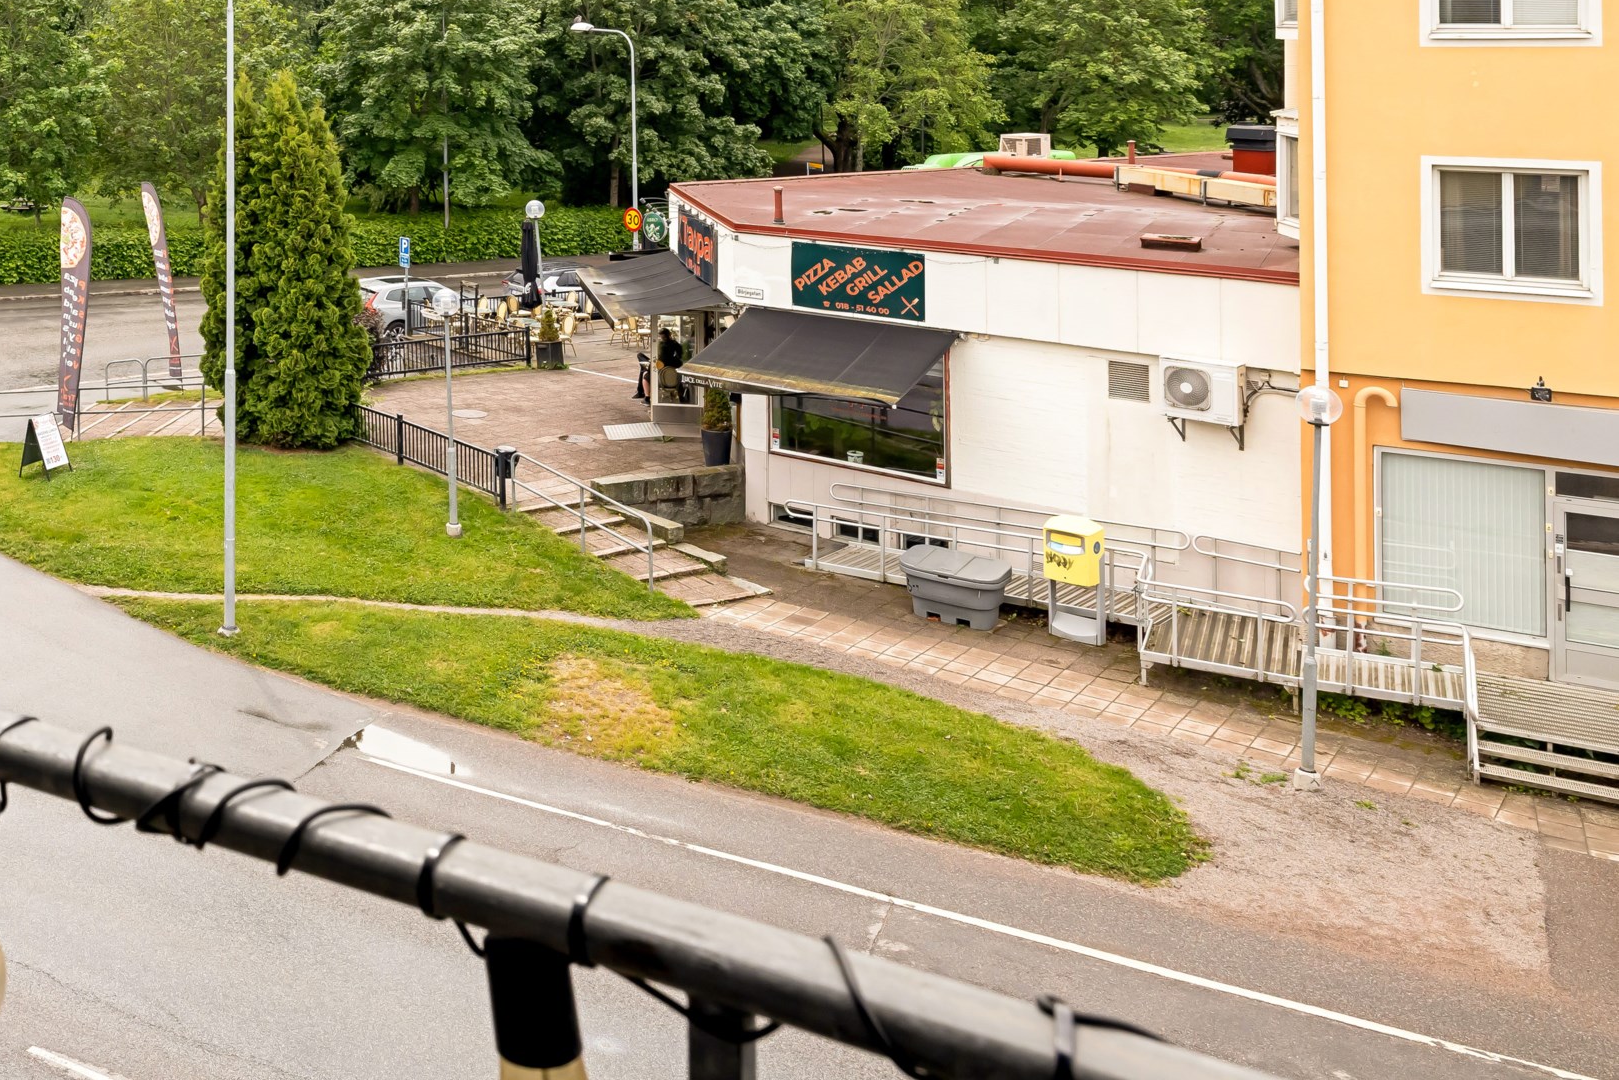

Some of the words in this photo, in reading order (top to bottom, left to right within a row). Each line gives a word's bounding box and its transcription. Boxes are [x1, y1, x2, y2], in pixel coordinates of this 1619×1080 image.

[627, 213, 639, 226] 30
[794, 258, 836, 291] PIZZA
[818, 256, 867, 296] KEBAB
[845, 265, 888, 296] GRILL
[867, 261, 924, 304] SALLAD
[835, 302, 849, 310] 018
[856, 304, 864, 312] 51
[866, 305, 876, 313] 40
[878, 306, 890, 315] 00
[681, 375, 695, 384] LUCE
[708, 379, 723, 388] VITE
